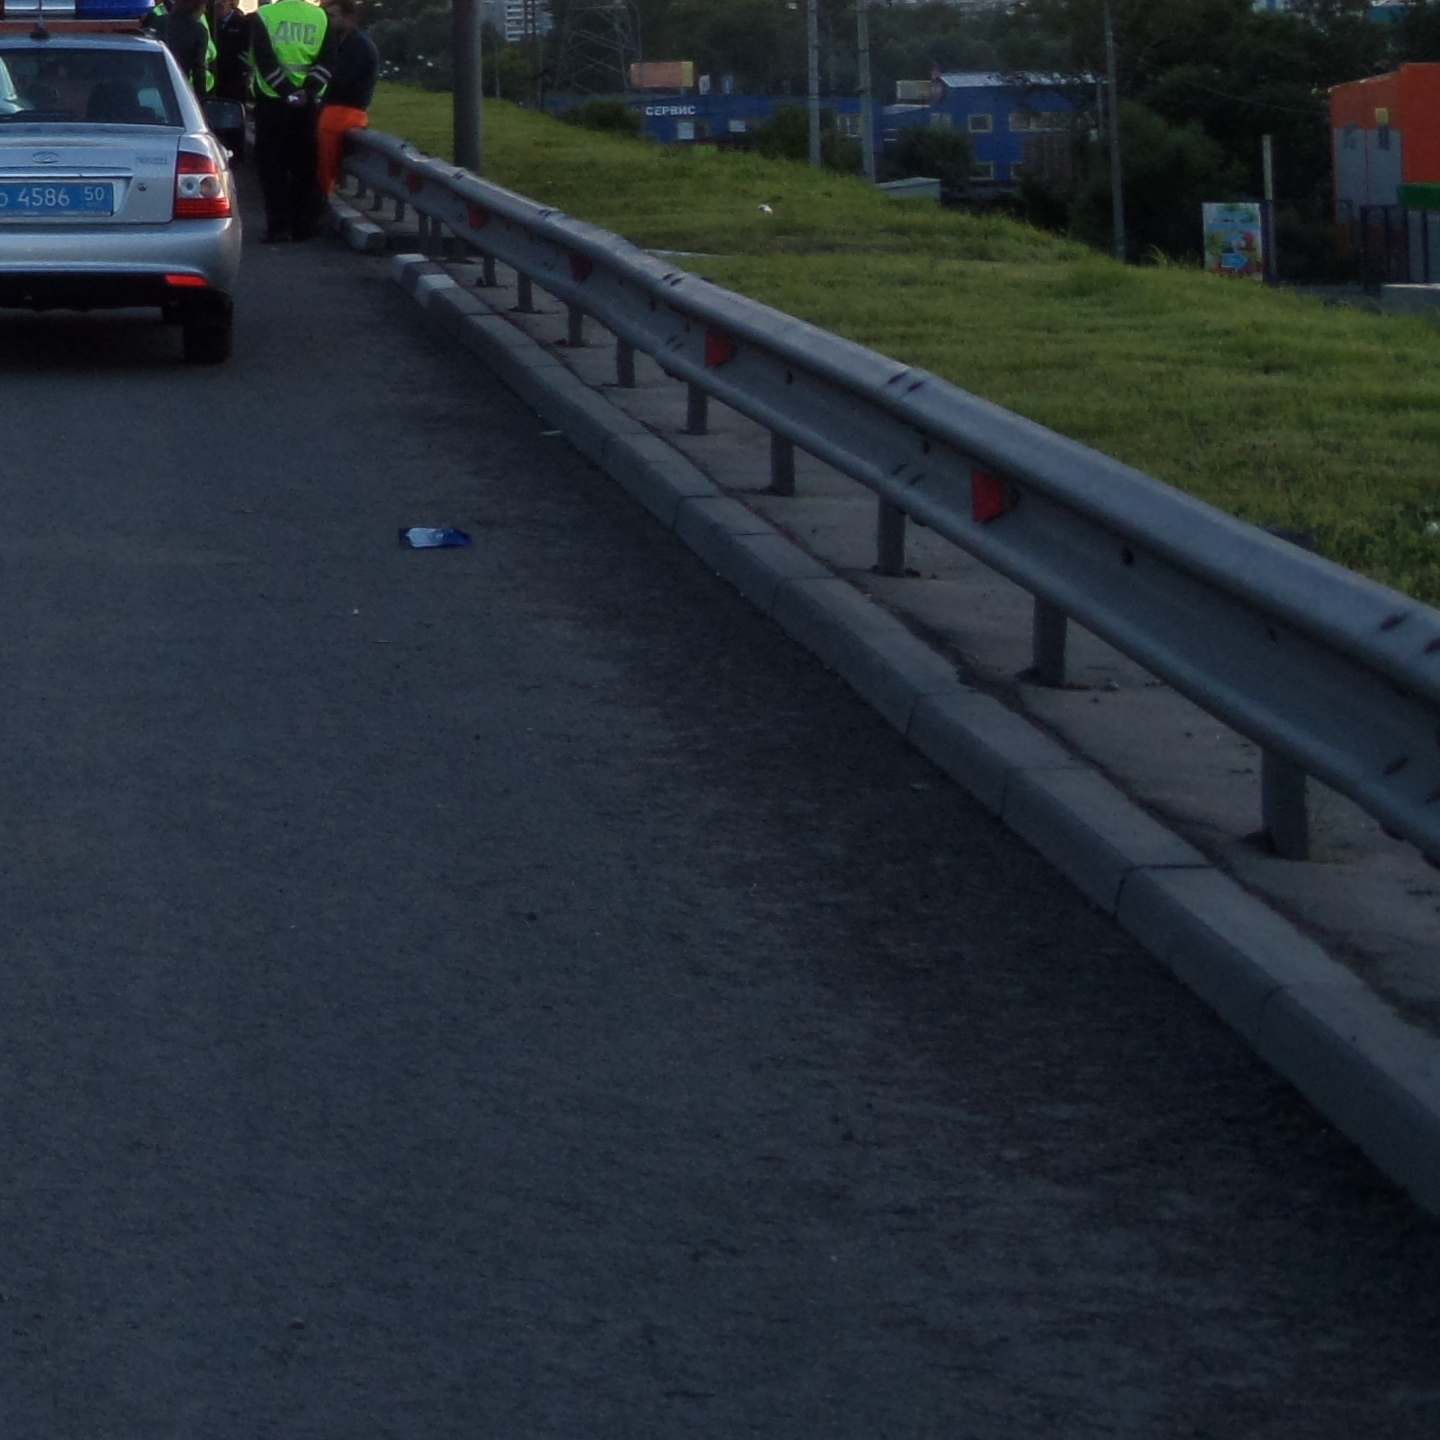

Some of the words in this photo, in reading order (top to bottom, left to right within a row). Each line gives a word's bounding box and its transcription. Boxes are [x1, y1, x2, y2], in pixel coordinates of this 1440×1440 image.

[271, 20, 317, 45] ДПС
[645, 105, 696, 116] СЕРВИС
[17, 187, 70, 207] 4586
[84, 186, 105, 202] 50
